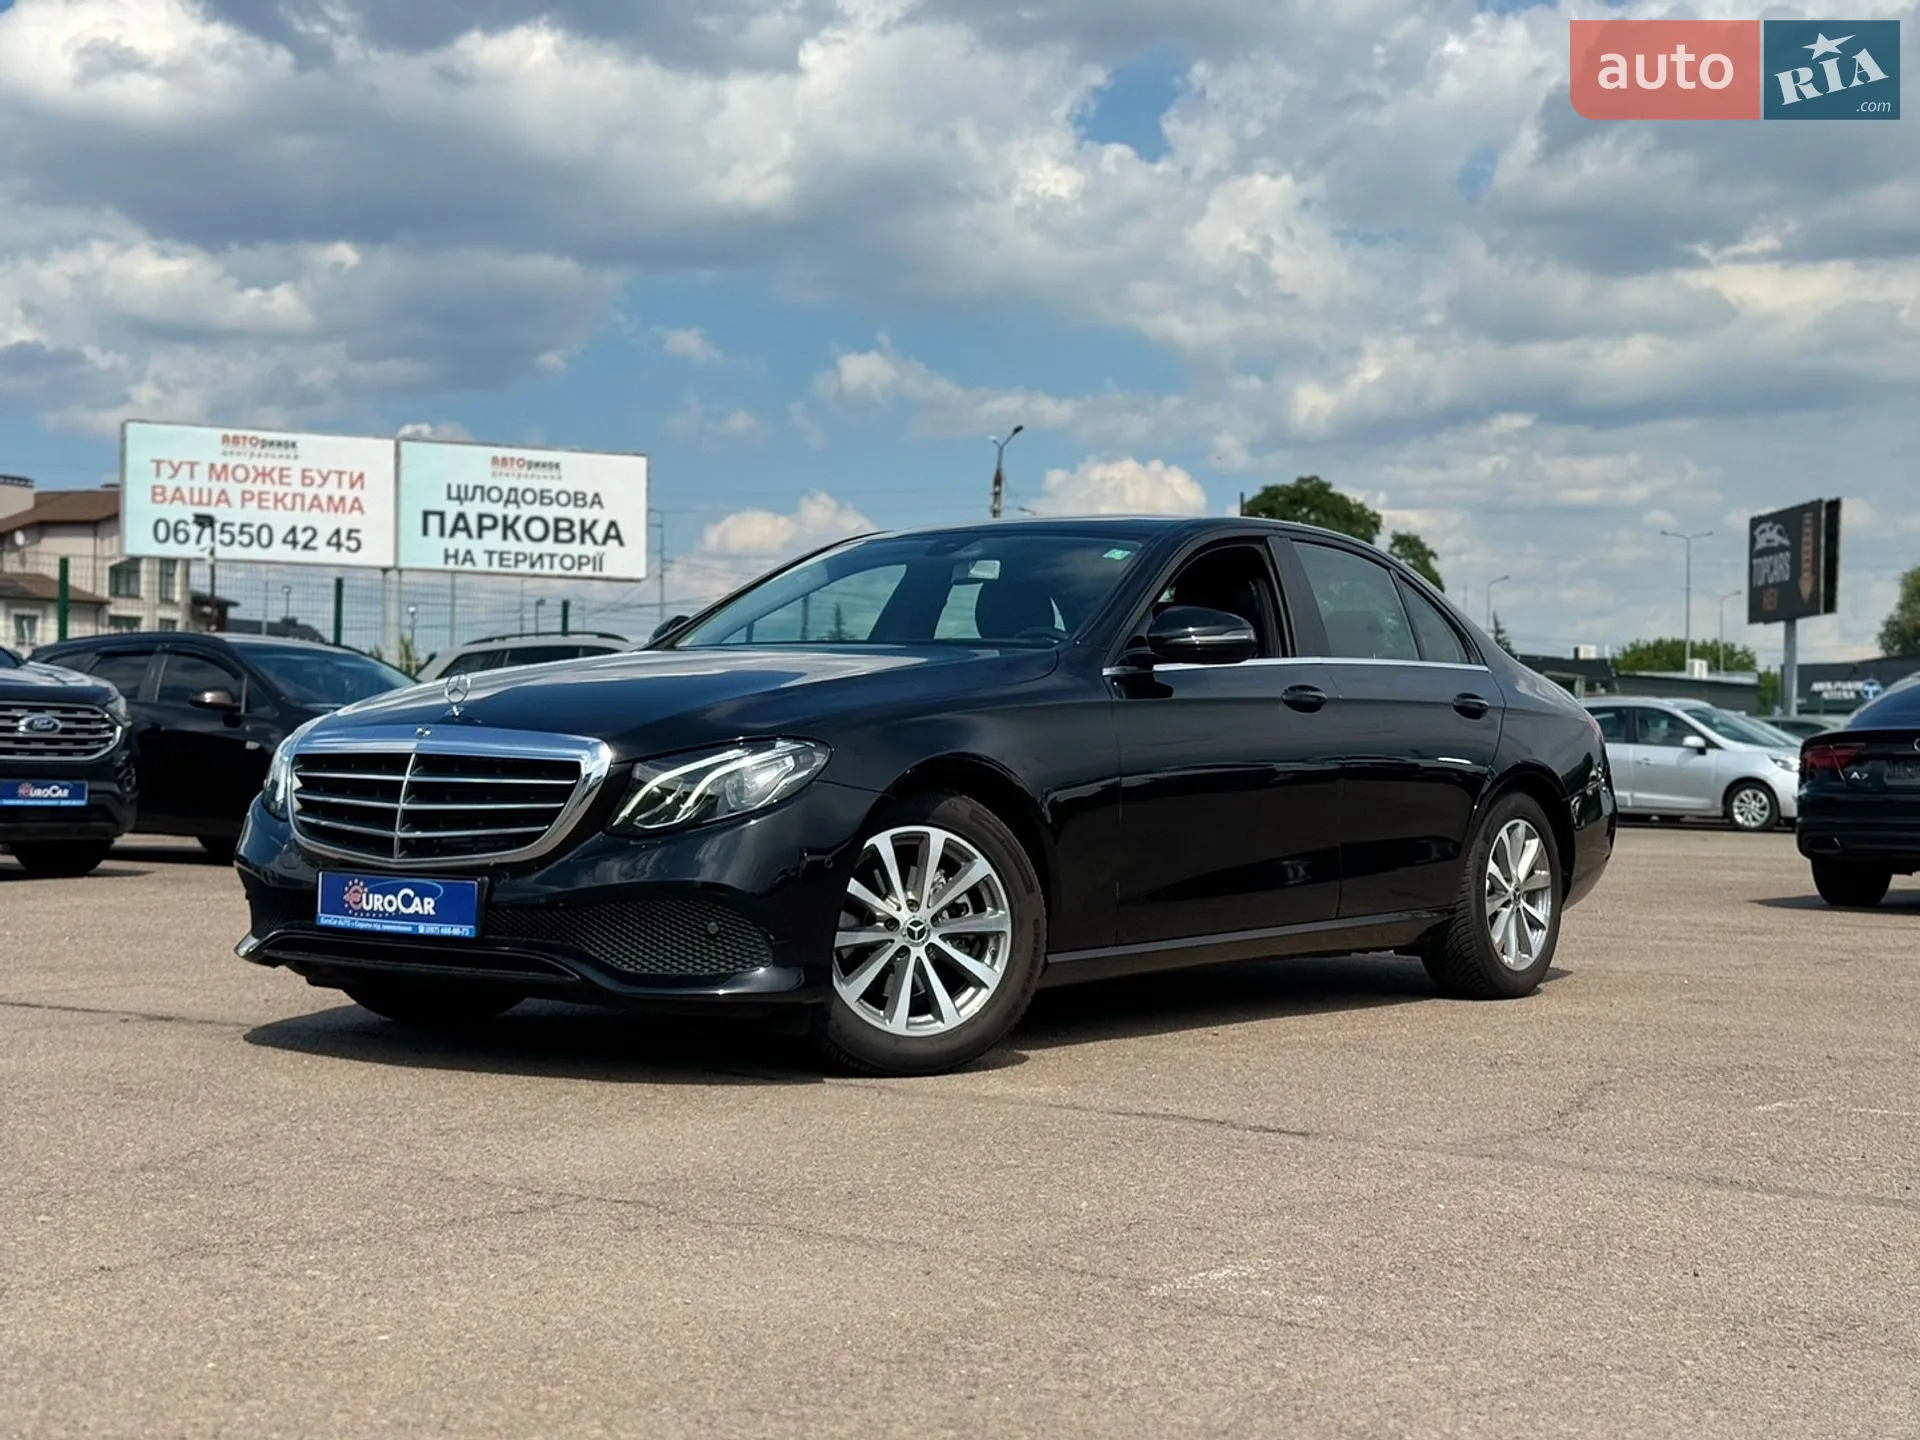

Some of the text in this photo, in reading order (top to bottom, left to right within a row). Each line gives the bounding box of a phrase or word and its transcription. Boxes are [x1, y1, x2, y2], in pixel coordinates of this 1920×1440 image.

[150, 458, 366, 490] ТУТ МОЖЕ БУТИ
[151, 484, 365, 515] ВАША РЕКЛАМА
[446, 483, 604, 509] ЦІЛОДОБОВА
[153, 517, 362, 553] 067 550 42 45
[421, 509, 625, 547] ПАРКОВКА
[444, 548, 605, 572] НА ТЕРИТОРІЇ
